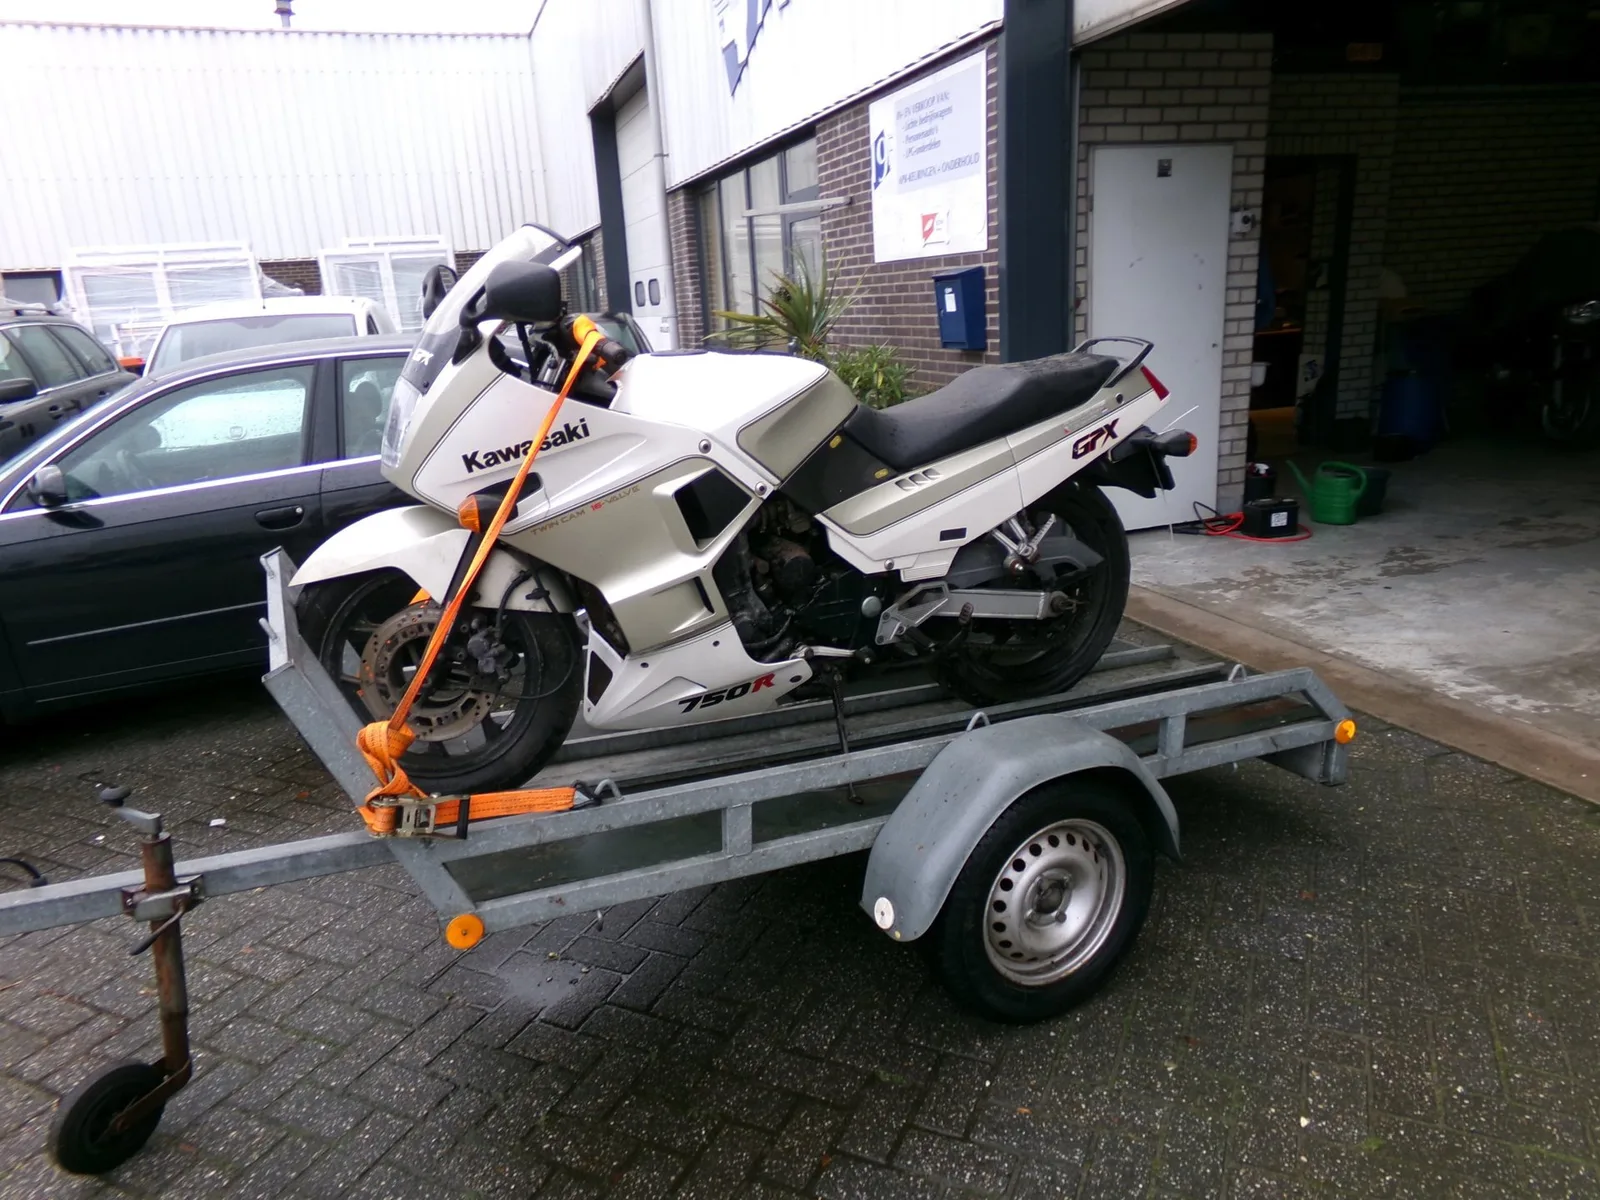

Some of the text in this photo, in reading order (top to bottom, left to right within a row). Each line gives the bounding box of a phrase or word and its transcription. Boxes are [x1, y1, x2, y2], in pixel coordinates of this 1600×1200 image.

[461, 417, 590, 474] Kawasaki
[1072, 417, 1120, 460] GPX
[530, 520, 560, 536] TWIN
[560, 509, 586, 523] CAM
[678, 672, 775, 714] 750R
